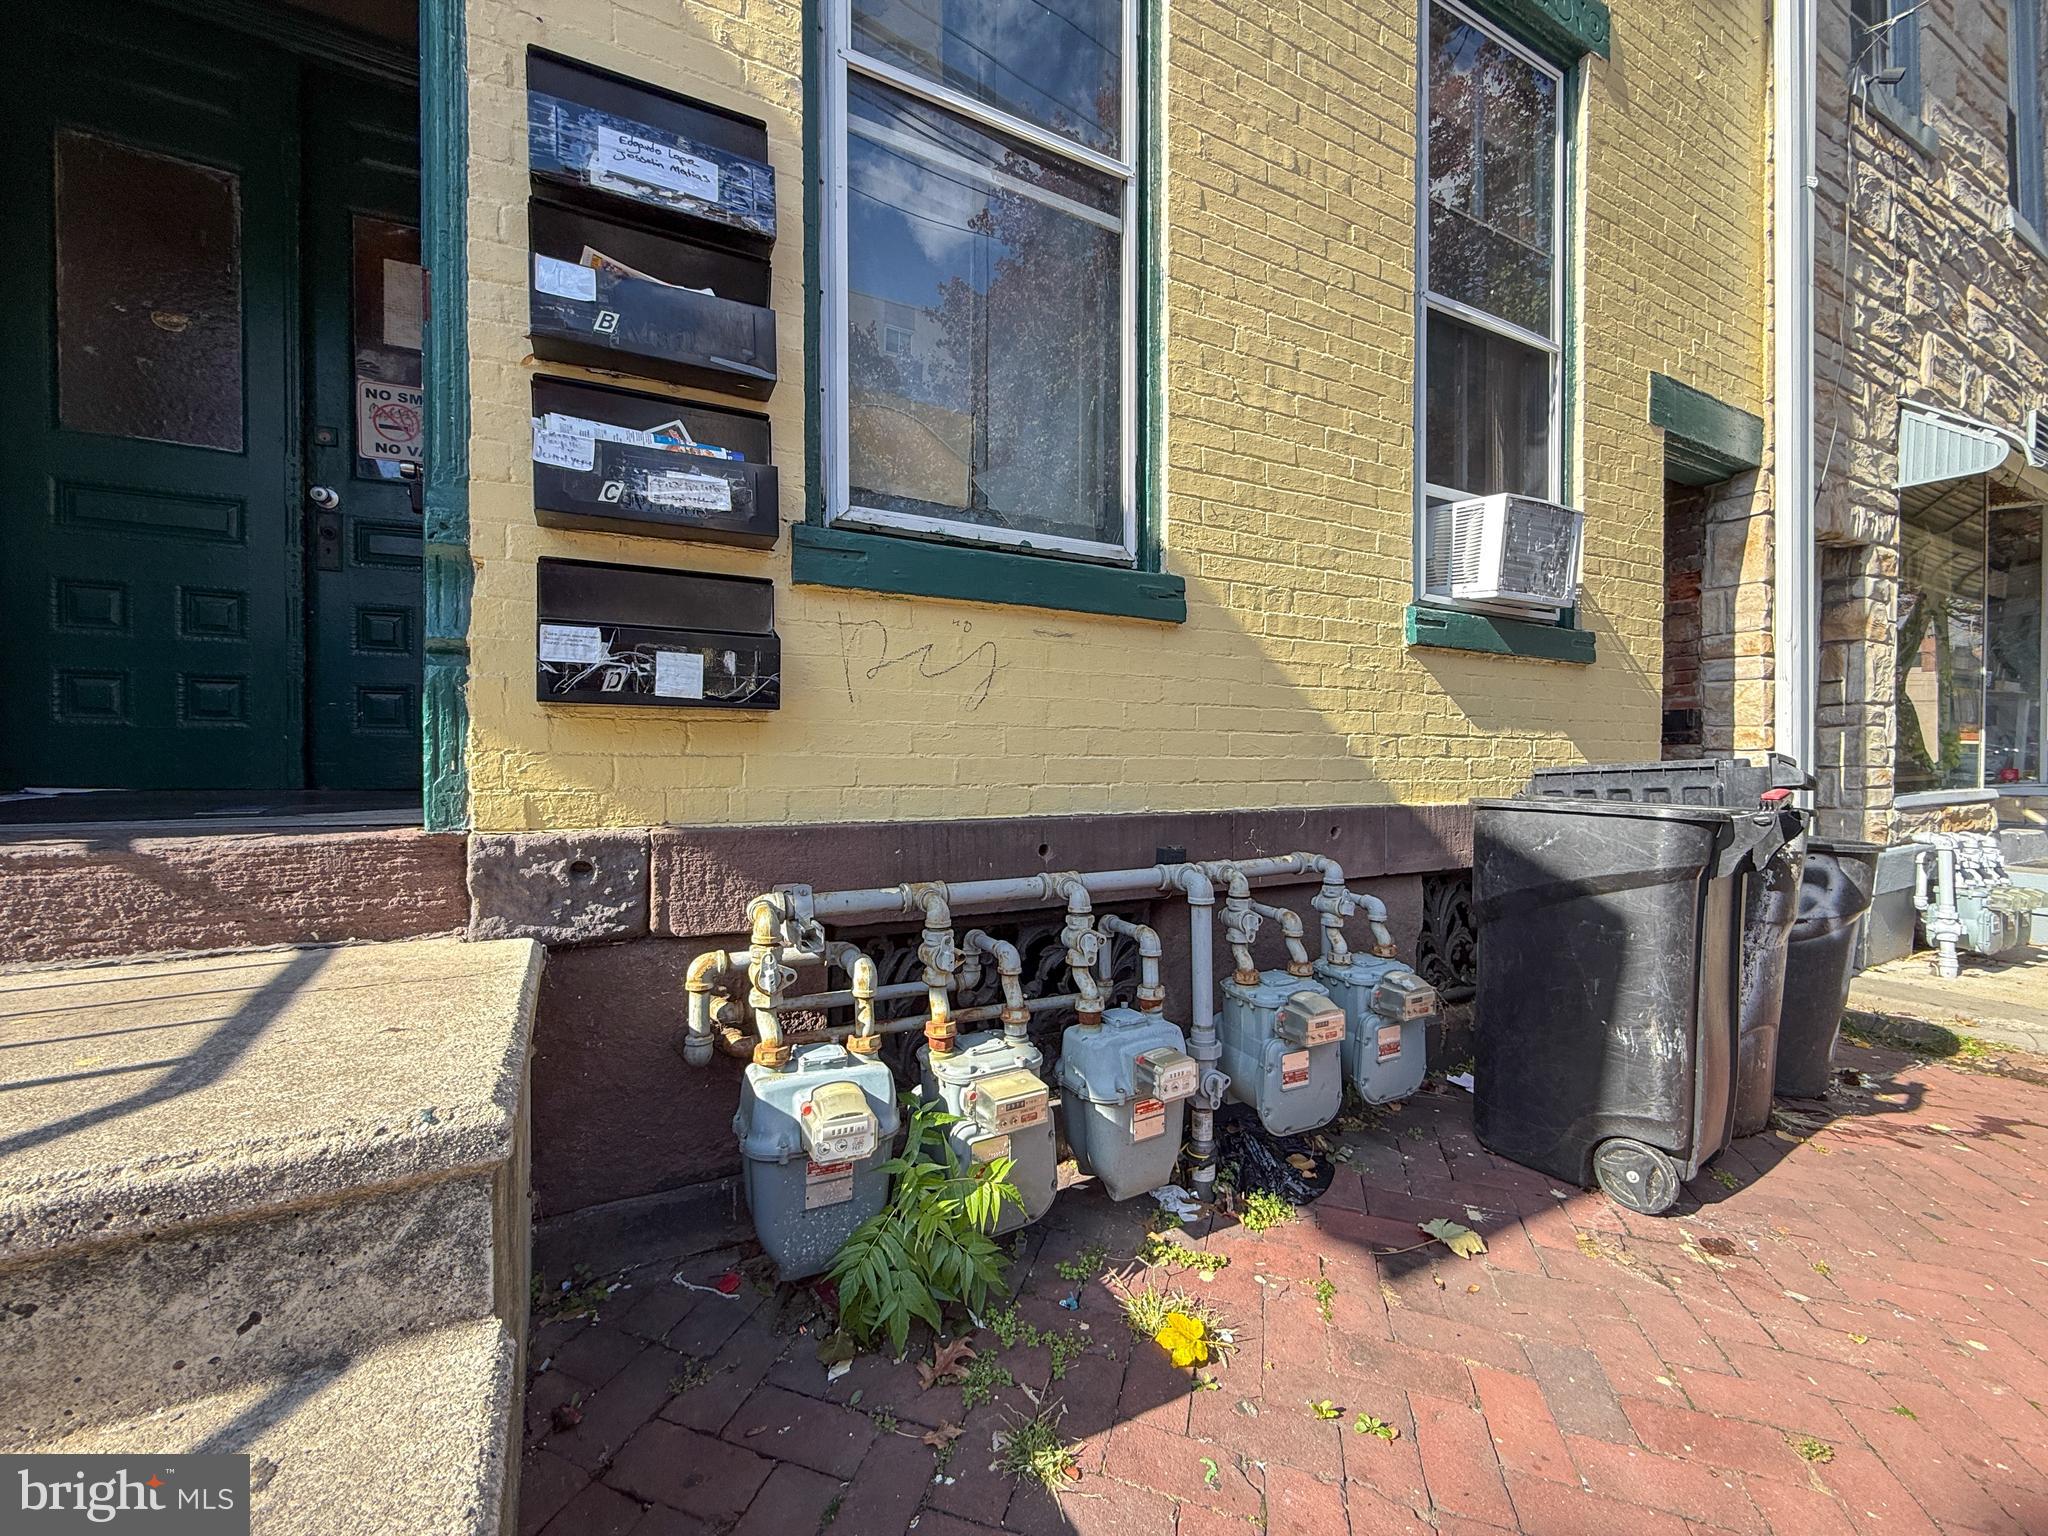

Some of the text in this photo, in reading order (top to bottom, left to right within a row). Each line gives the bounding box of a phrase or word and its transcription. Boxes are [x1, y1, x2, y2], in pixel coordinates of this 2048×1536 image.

[598, 313, 615, 330] B
[365, 388, 391, 400] NO
[375, 442, 401, 455] NO
[604, 483, 618, 501] C
[606, 671, 622, 689] D
